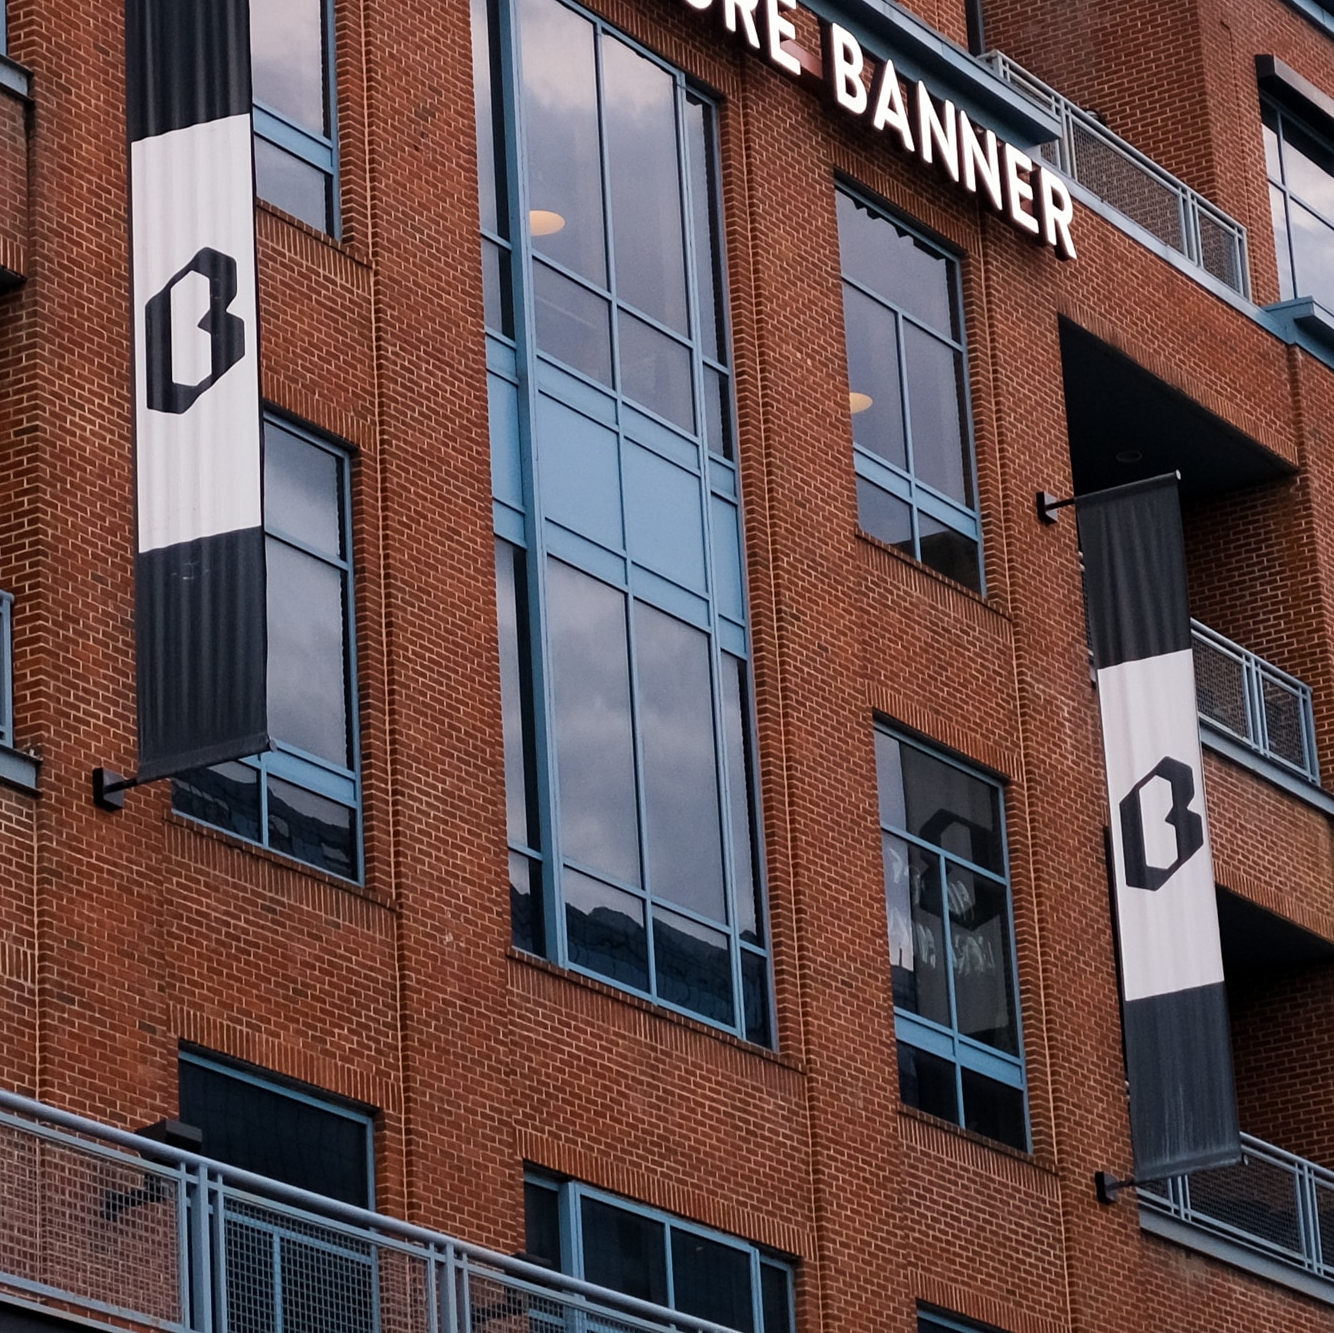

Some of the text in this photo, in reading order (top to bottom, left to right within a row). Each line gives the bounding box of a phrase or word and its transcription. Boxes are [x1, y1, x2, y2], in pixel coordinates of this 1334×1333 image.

[831, 22, 1078, 260] BANNER
[145, 246, 246, 415] B
[1119, 755, 1205, 892] B
